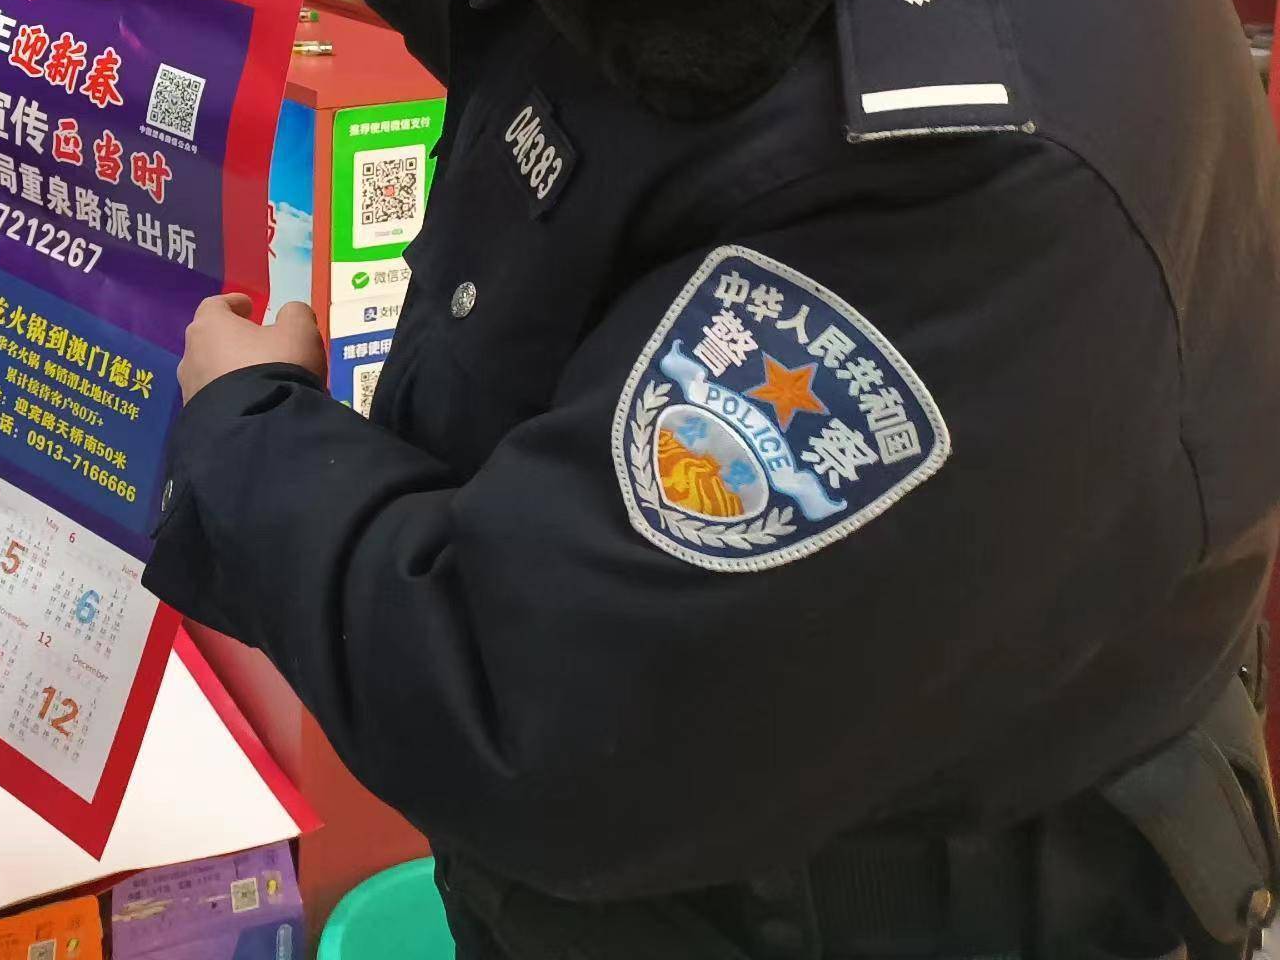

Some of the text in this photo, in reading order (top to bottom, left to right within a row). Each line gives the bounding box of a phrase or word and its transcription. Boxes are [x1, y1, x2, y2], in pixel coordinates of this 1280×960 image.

[380, 305, 401, 318] 支付
[713, 270, 921, 465] 中华人民共和国
[705, 388, 791, 473] POLICE
[1, 539, 24, 575] 5
[69, 532, 76, 543] 6
[75, 589, 99, 625] 6
[38, 631, 109, 682] 12 December
[38, 686, 79, 737] 12
